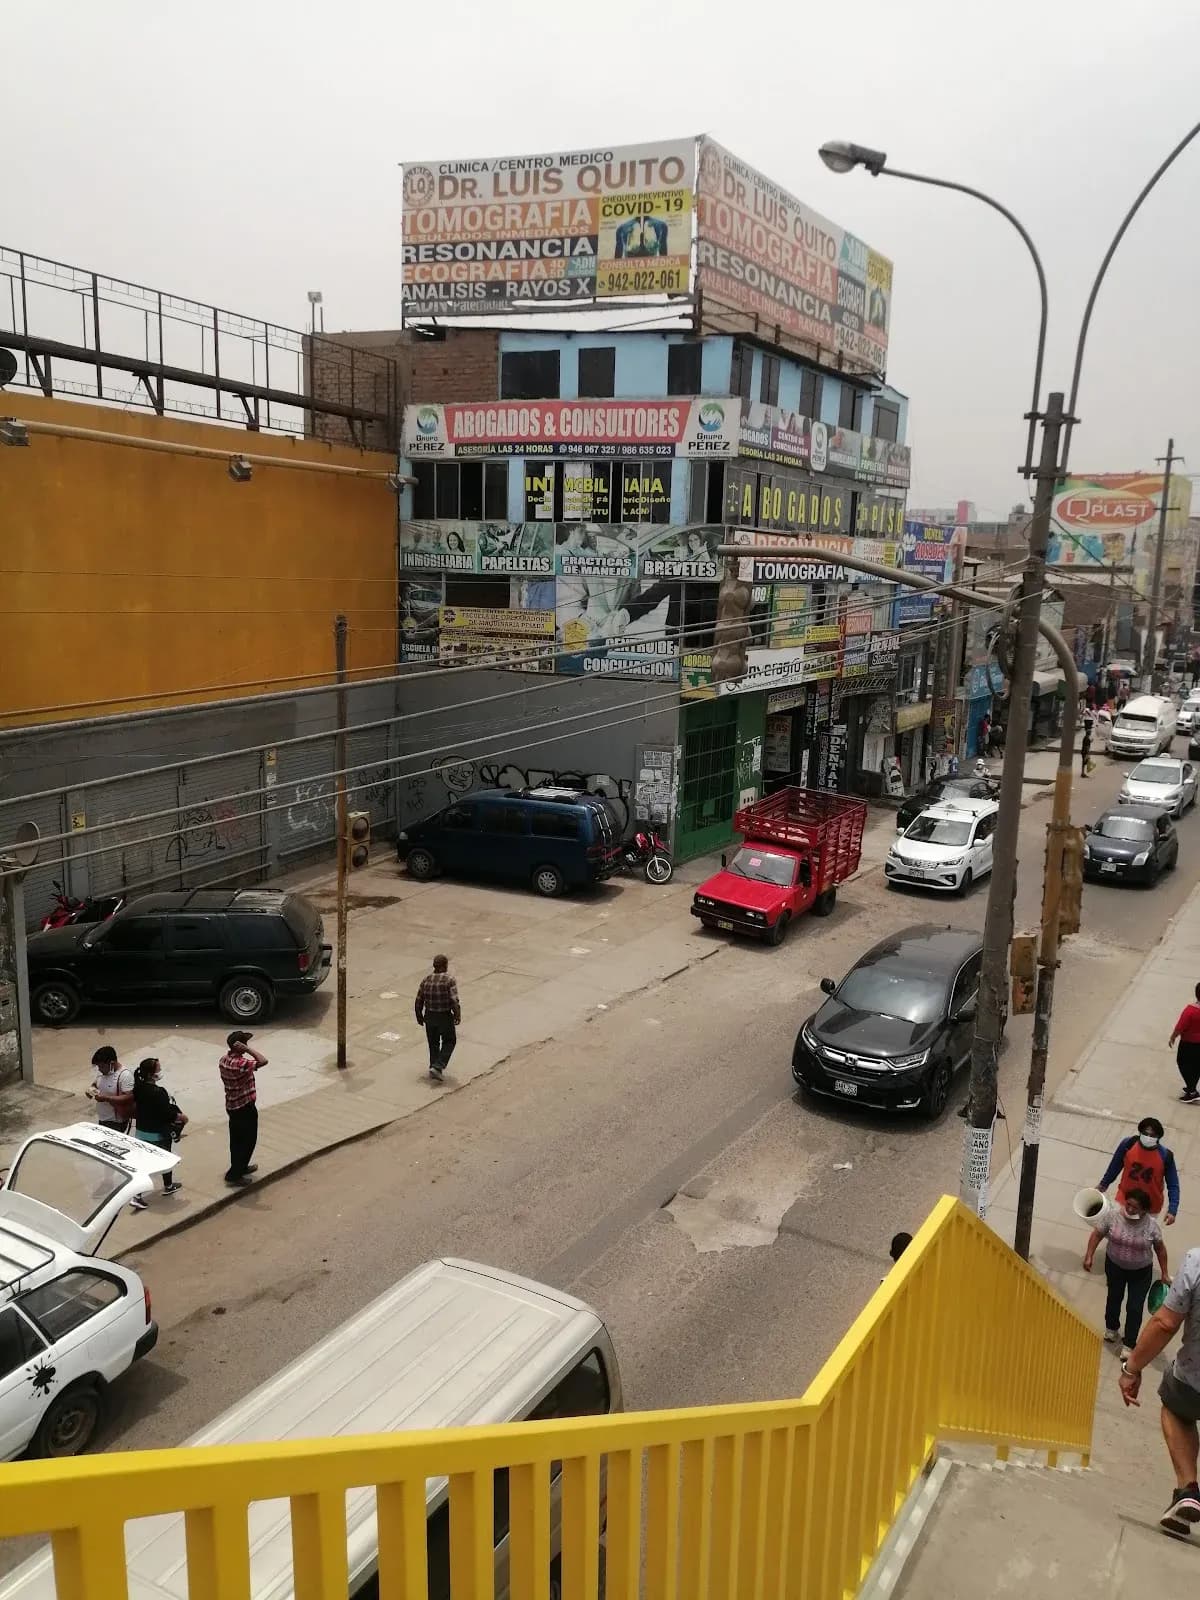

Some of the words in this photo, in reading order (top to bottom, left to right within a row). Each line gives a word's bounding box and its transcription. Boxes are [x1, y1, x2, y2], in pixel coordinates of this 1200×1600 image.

[439, 161, 489, 175] CLINICA
[500, 157, 553, 171] CENTRO
[559, 151, 614, 167] MEDICO
[439, 174, 483, 201] DR.
[493, 167, 564, 198] LUIS
[576, 156, 685, 195] QUITO
[723, 155, 750, 180] CLINICA
[753, 174, 778, 200] CENTRO
[401, 201, 592, 235] TOMOGRAFIA
[602, 197, 684, 217] COVID-19
[723, 167, 749, 209] DR.
[754, 187, 788, 233] LUIS
[793, 216, 837, 261] QUITO
[402, 231, 491, 244] RESULTADOS
[496, 225, 589, 240] INMEDIATOS
[700, 198, 833, 294] TOMOGRAFIA
[401, 236, 594, 264] RESONANCIA
[401, 258, 548, 284] ECOGRAFIA
[608, 269, 681, 292] 942-022-061
[699, 240, 832, 324] RESONANCIA
[401, 282, 487, 301] ANALISIS
[506, 278, 571, 298] RAYOS
[576, 278, 591, 295] X
[454, 407, 541, 438] ABOGADOS
[543, 411, 556, 437] &
[559, 407, 680, 438] CONSULTORES
[497, 445, 513, 454] LAS
[514, 445, 524, 453] 24
[526, 444, 554, 453] HORAS
[568, 444, 583, 454] 946
[584, 444, 598, 454] 067
[601, 445, 616, 454] 325
[622, 445, 637, 455] 986
[639, 445, 654, 455] 635
[656, 446, 672, 455] 023
[743, 484, 842, 527] ABOGADOS
[481, 556, 550, 572] PAPELETAS
[561, 556, 632, 568] PRACTICAS
[563, 565, 579, 575] DE
[580, 566, 630, 577] MANEJO
[643, 560, 717, 577] BREVETES
[756, 562, 845, 581] TOMOGRAFIA
[401, 643, 433, 653] ESCUELA
[583, 657, 673, 677] CONCILIACION
[683, 654, 712, 668] ABOGAD
[827, 735, 841, 789] DENTAL
[1129, 1162, 1154, 1184] 24
